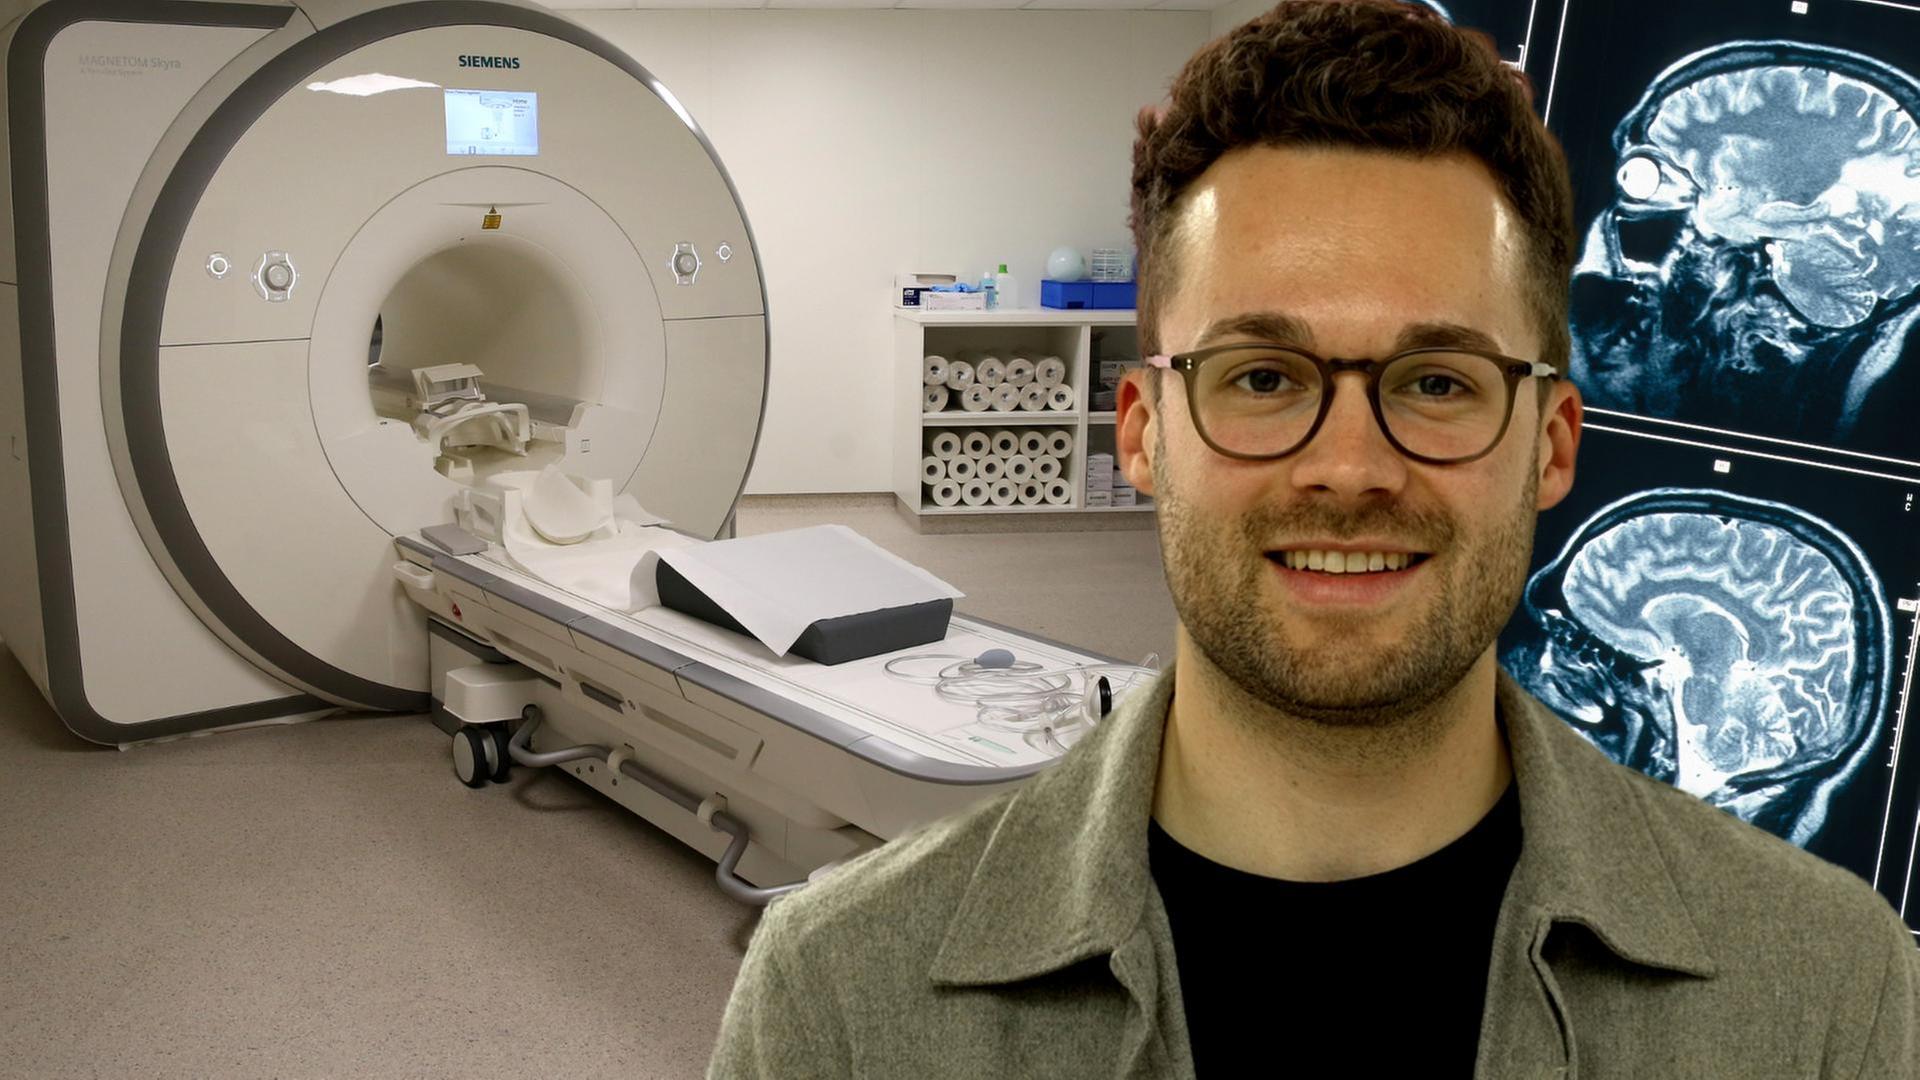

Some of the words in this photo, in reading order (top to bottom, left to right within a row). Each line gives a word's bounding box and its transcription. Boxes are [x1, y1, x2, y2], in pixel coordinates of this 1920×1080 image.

[79, 54, 148, 68] MAGNETOM
[150, 56, 182, 71] Skyra
[458, 54, 520, 69] SIEMENS
